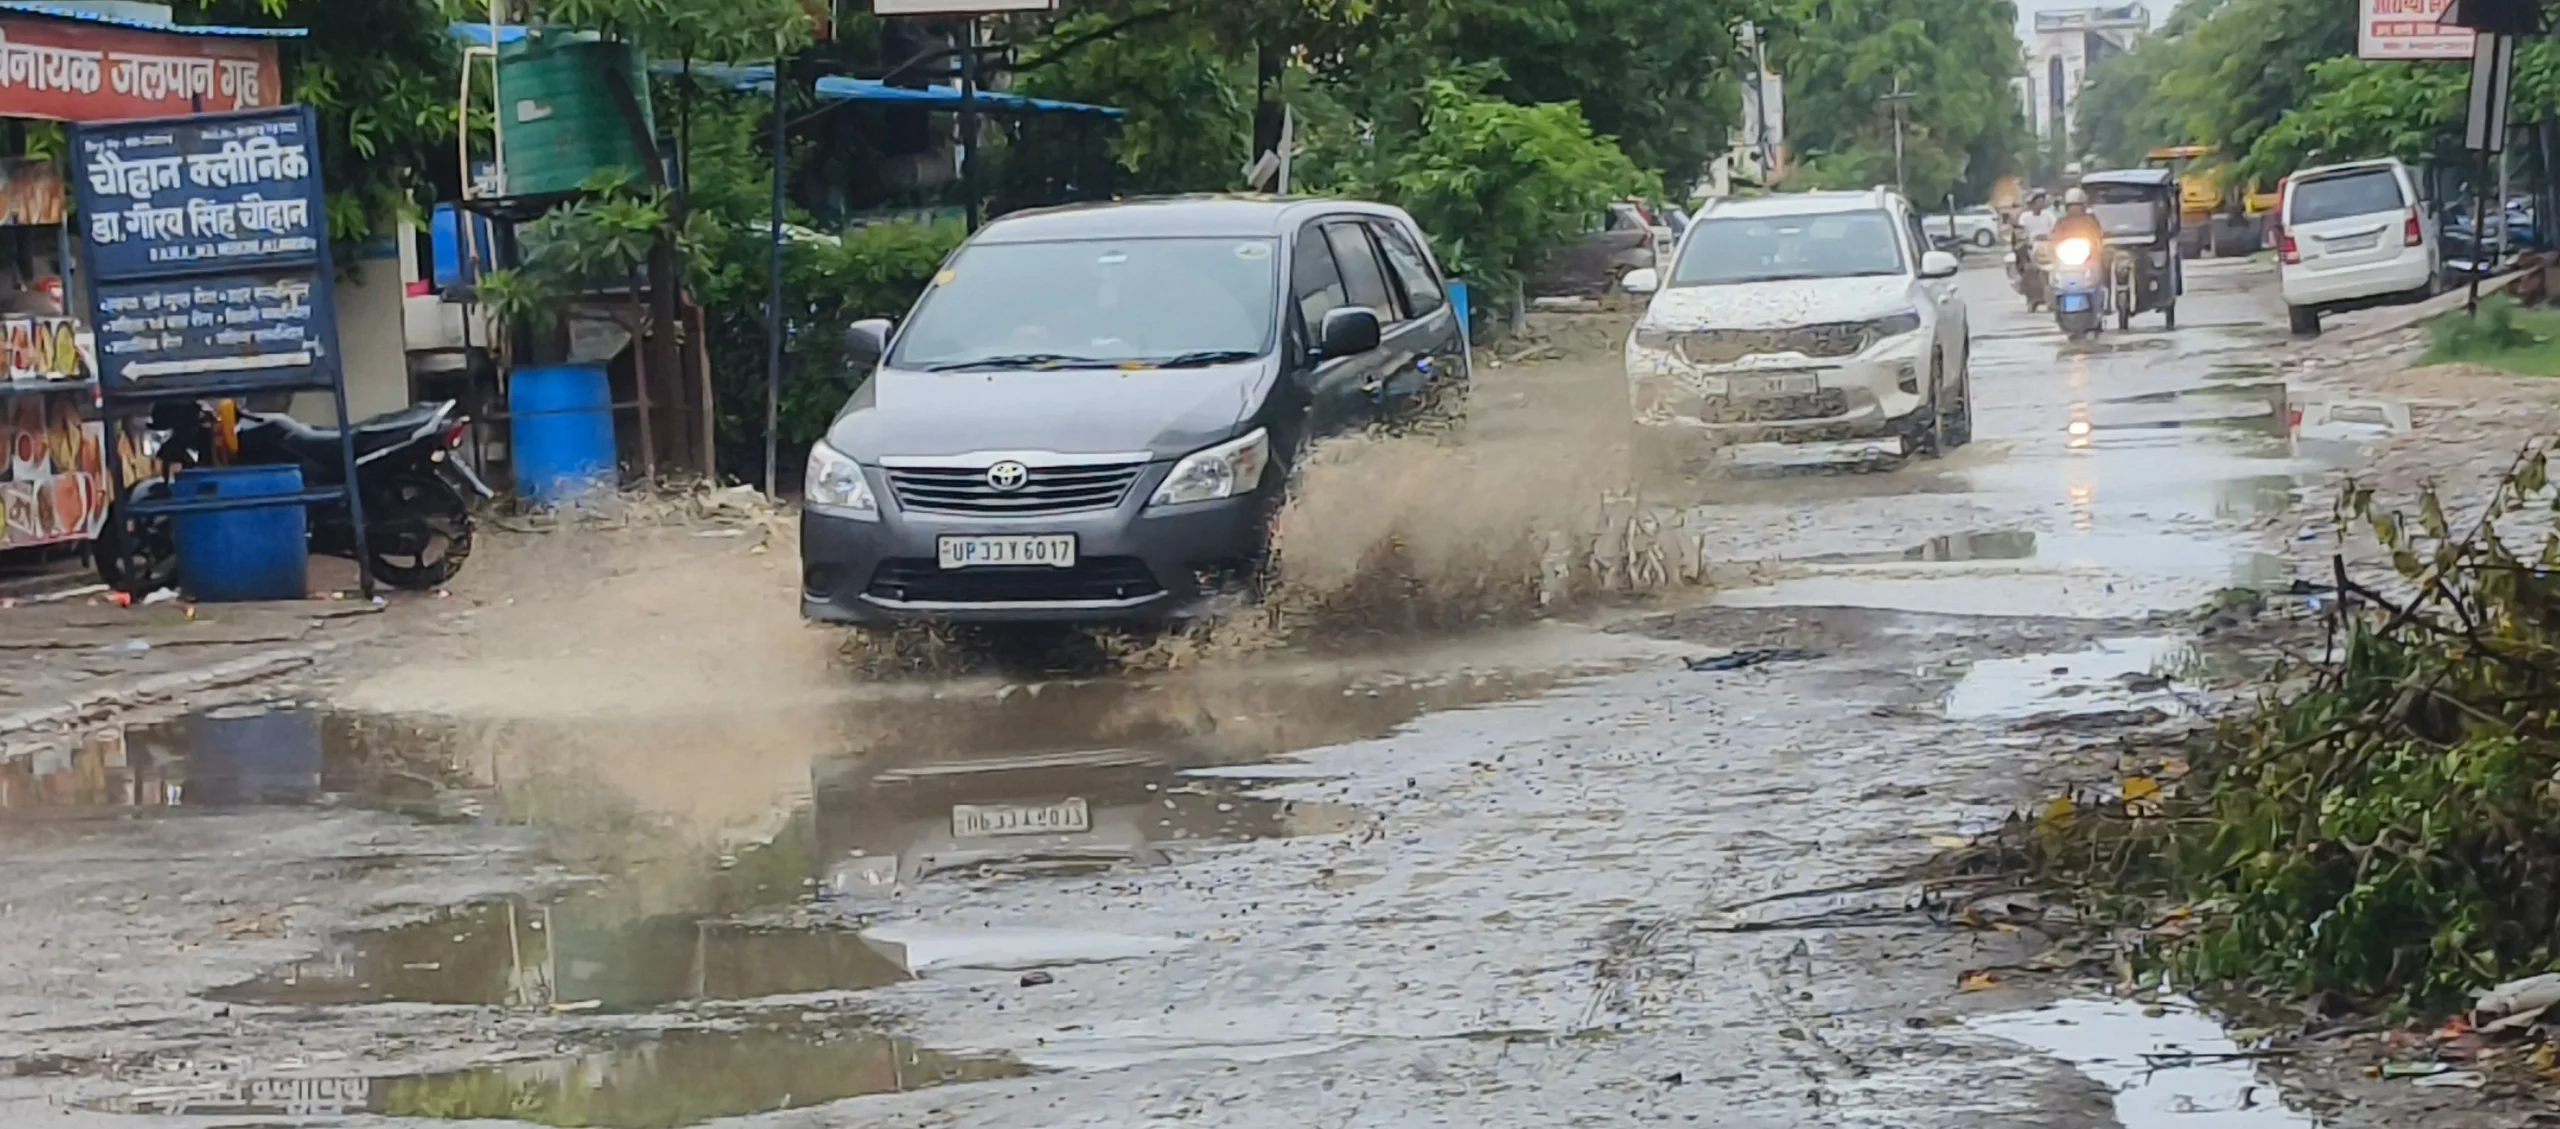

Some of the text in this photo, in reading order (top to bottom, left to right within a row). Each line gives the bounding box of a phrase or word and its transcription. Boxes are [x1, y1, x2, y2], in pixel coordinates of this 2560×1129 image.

[108, 53, 214, 99] जलपान
[219, 59, 259, 110] गृह
[87, 136, 309, 199] चौहान क्लीनिक
[188, 197, 237, 239] सिंह
[236, 192, 308, 234] चौहान
